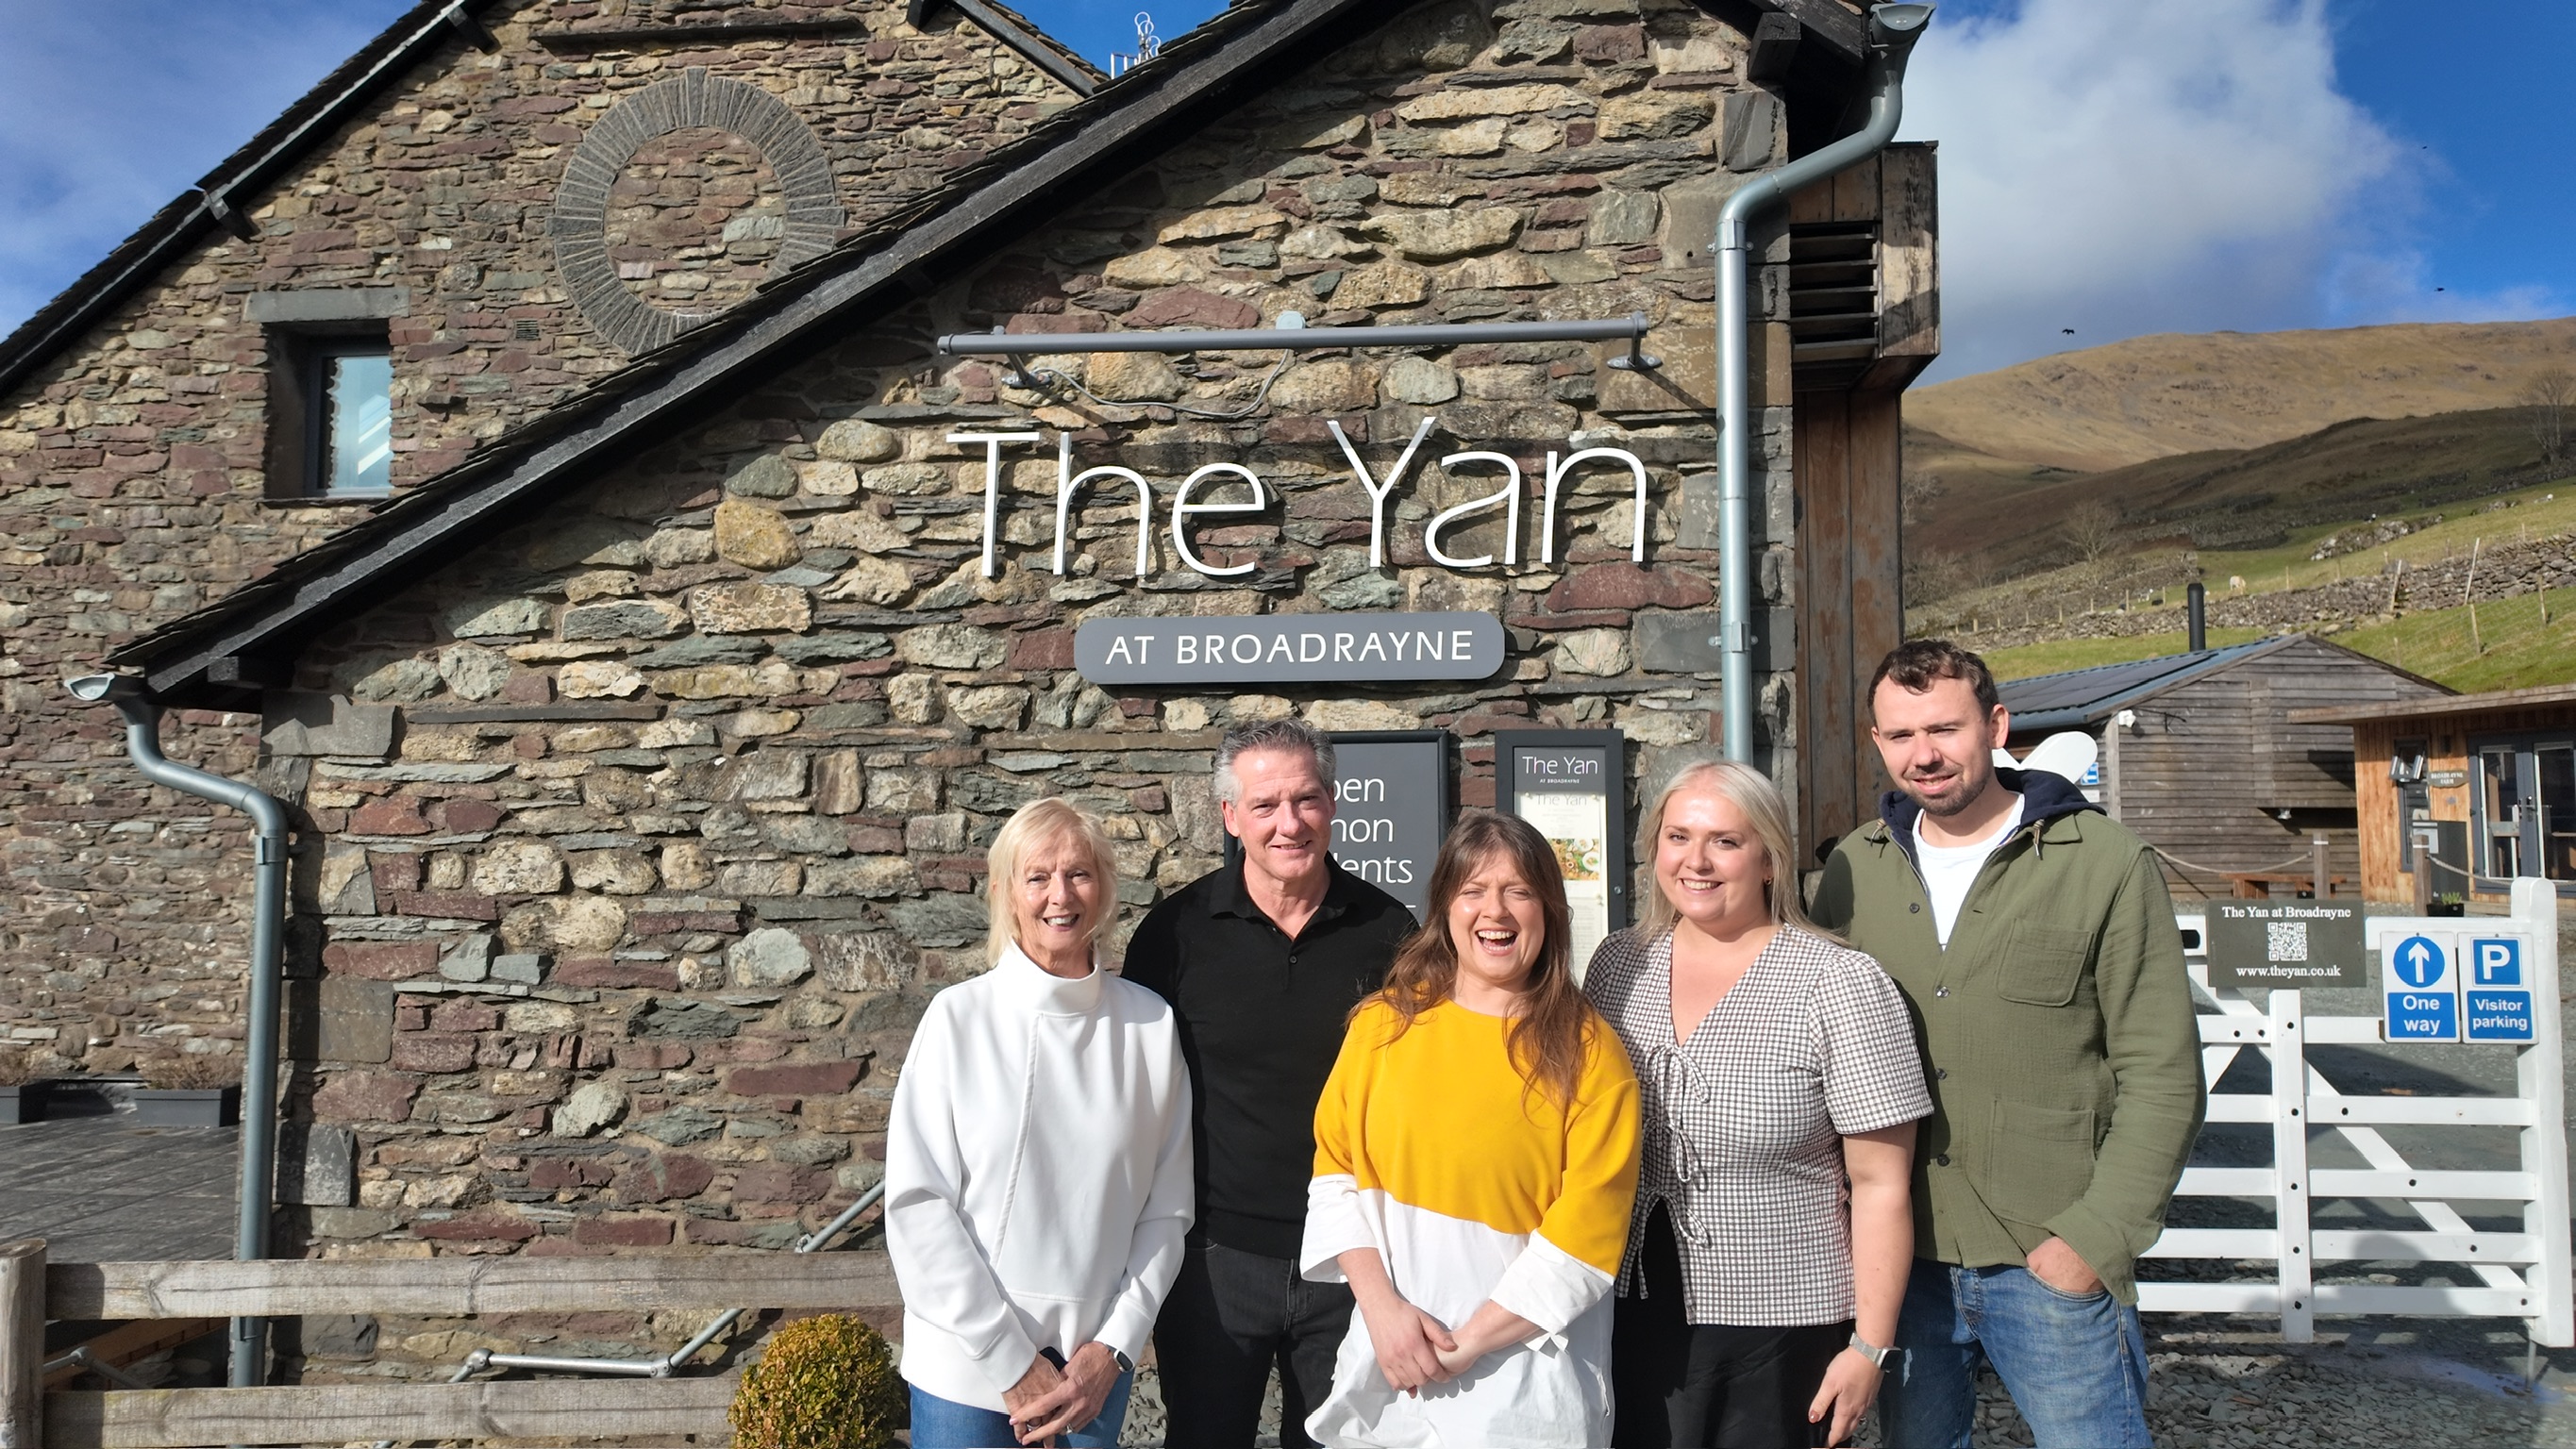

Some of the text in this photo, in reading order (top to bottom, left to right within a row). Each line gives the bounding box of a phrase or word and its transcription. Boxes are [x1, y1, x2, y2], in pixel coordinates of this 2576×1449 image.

[946, 416, 1647, 576] The Yan
[1105, 630, 1473, 665] AT BROADRAYNE
[1522, 756, 1598, 774] The Yan
[1536, 793, 1587, 806] The Yan
[2222, 907, 2351, 920] The Yan at Broadrayne
[2482, 944, 2511, 980] P
[2236, 965, 2341, 979] www.theyan.co.uk
[2402, 994, 2440, 1010] One
[2475, 998, 2523, 1011] Visitor
[2403, 1019, 2441, 1035] way
[2472, 1015, 2528, 1031] parking
